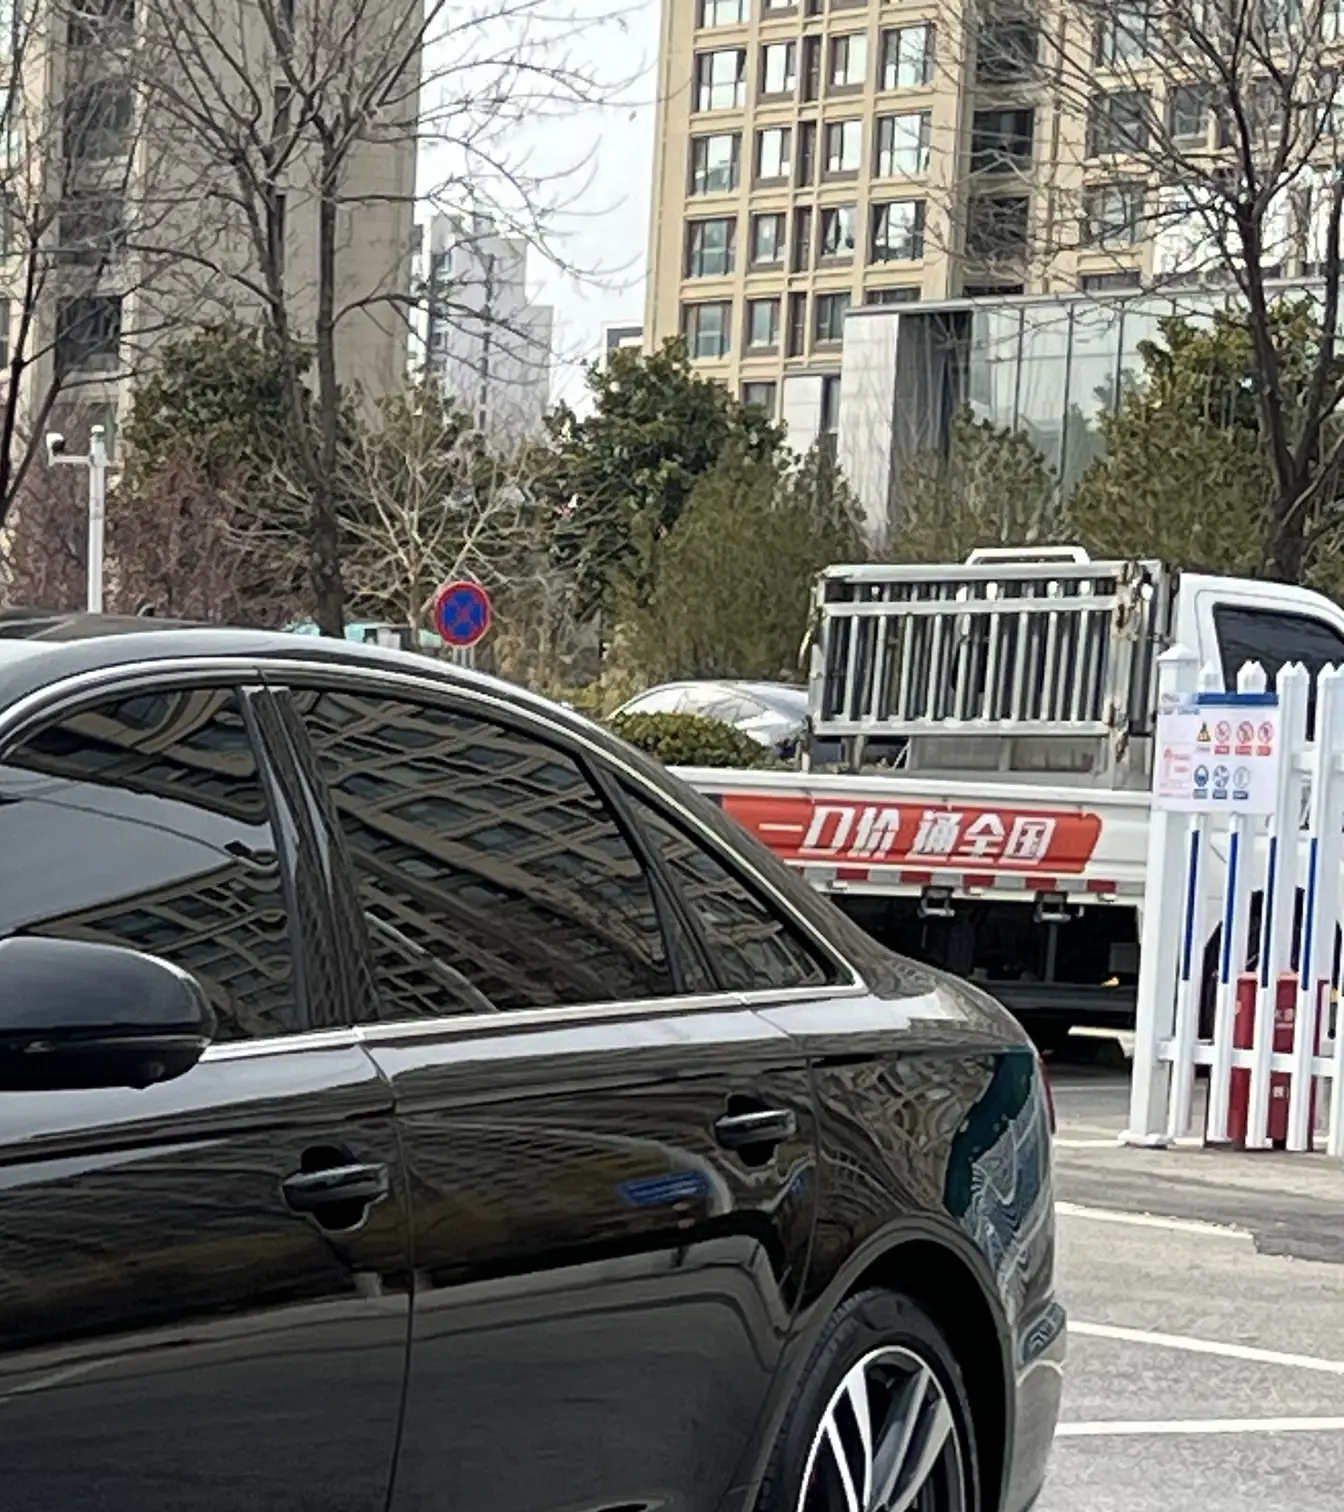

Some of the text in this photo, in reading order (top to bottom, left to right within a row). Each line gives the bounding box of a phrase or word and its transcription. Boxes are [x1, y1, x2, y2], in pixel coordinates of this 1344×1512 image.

[758, 806, 1056, 866] 一口价 通全国
